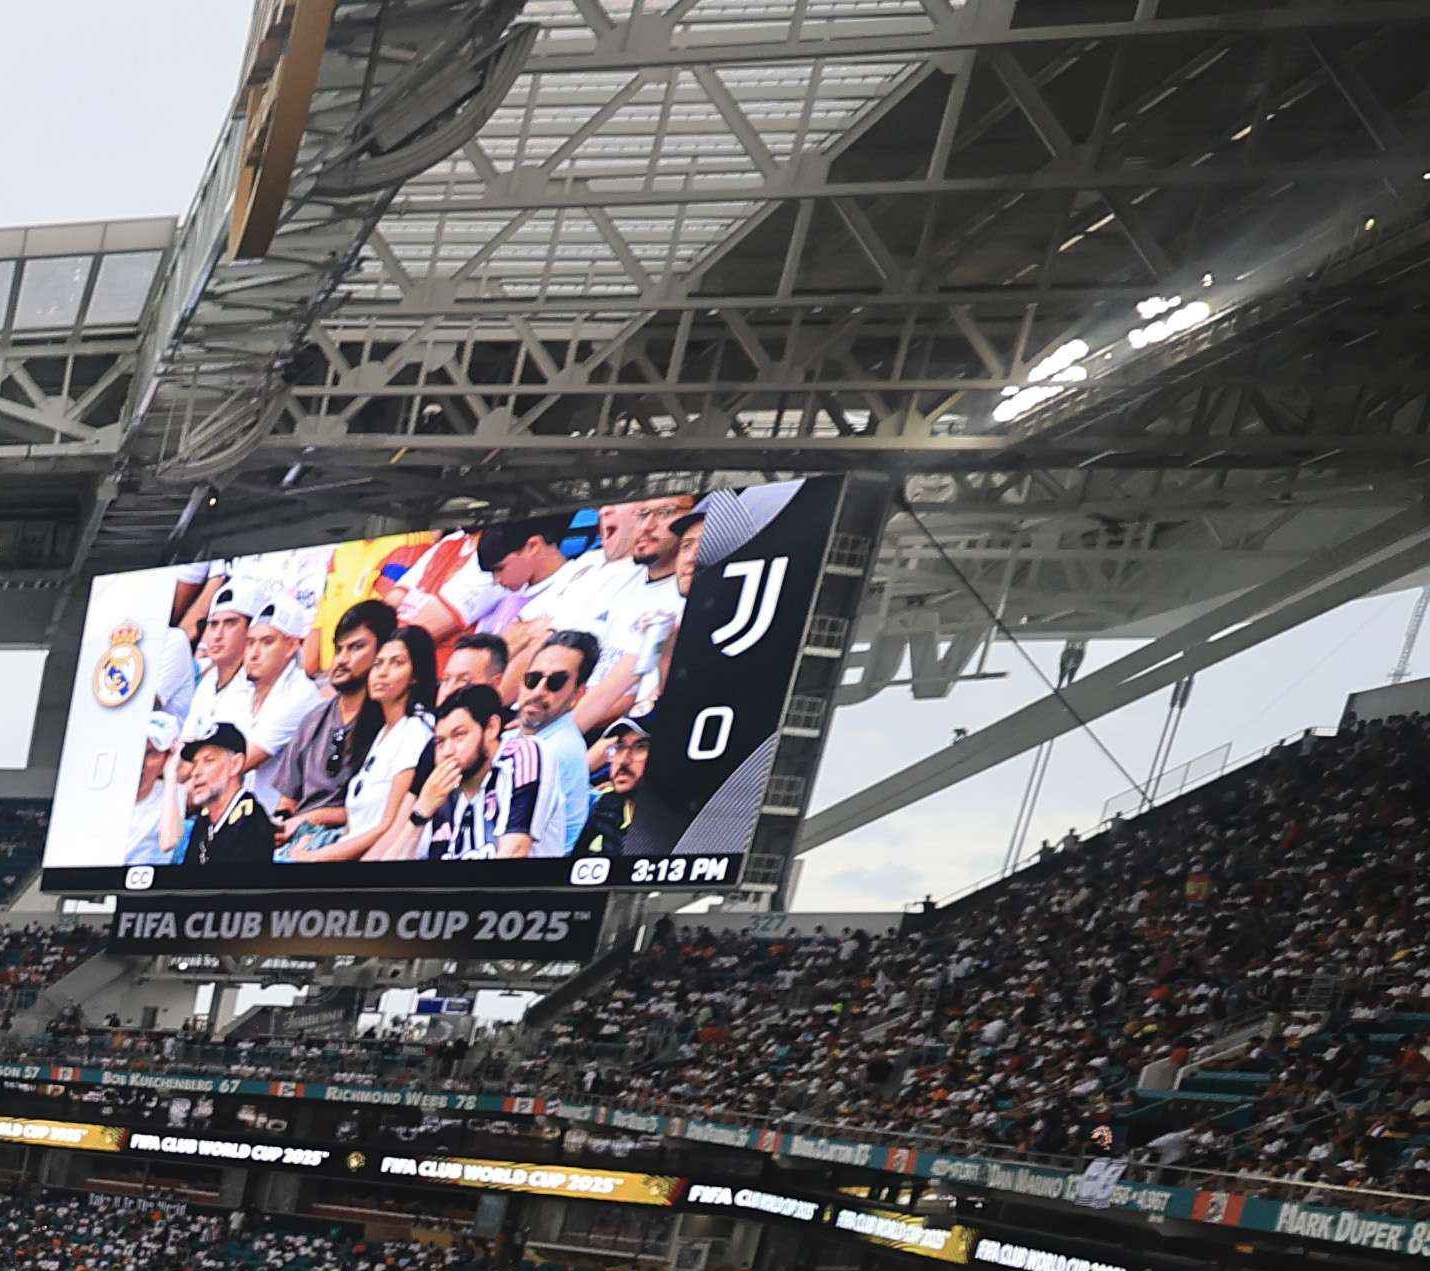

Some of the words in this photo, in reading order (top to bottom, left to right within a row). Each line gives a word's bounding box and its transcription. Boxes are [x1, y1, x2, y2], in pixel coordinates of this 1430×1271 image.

[631, 858, 686, 882] 3:13
[689, 858, 729, 881] PM
[118, 912, 177, 939] FIFA
[184, 911, 263, 939] CLUB
[270, 909, 390, 940] WORLD
[396, 910, 470, 940] CUP
[130, 1134, 161, 1151] FIFA
[161, 1137, 198, 1154] CLUB
[198, 1140, 251, 1159] WORLD
[251, 1145, 283, 1161] CUP
[381, 1157, 417, 1175] FIFA
[418, 1160, 463, 1179] CLUB
